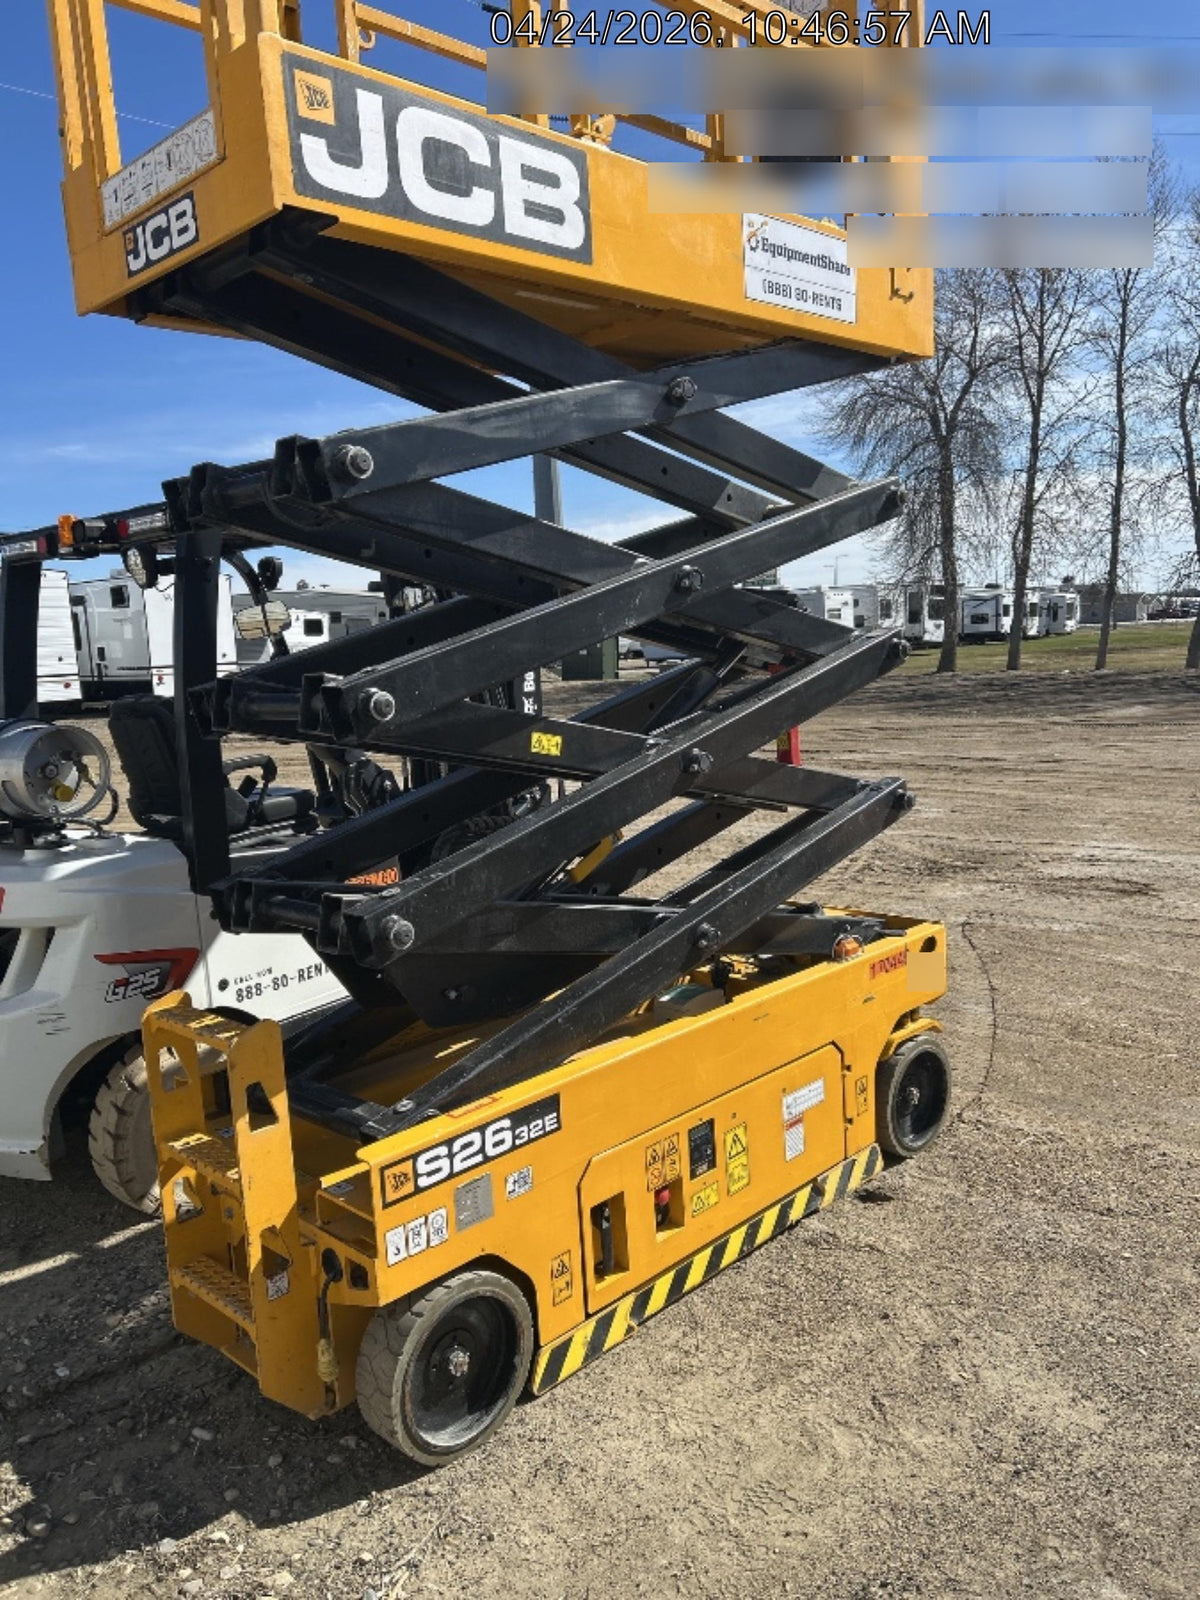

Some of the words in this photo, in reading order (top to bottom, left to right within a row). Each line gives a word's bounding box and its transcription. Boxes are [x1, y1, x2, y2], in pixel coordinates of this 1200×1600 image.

[300, 88, 588, 250] JCB
[127, 198, 197, 271] JCB
[105, 967, 162, 1003] G25
[416, 1118, 513, 1188] S26
